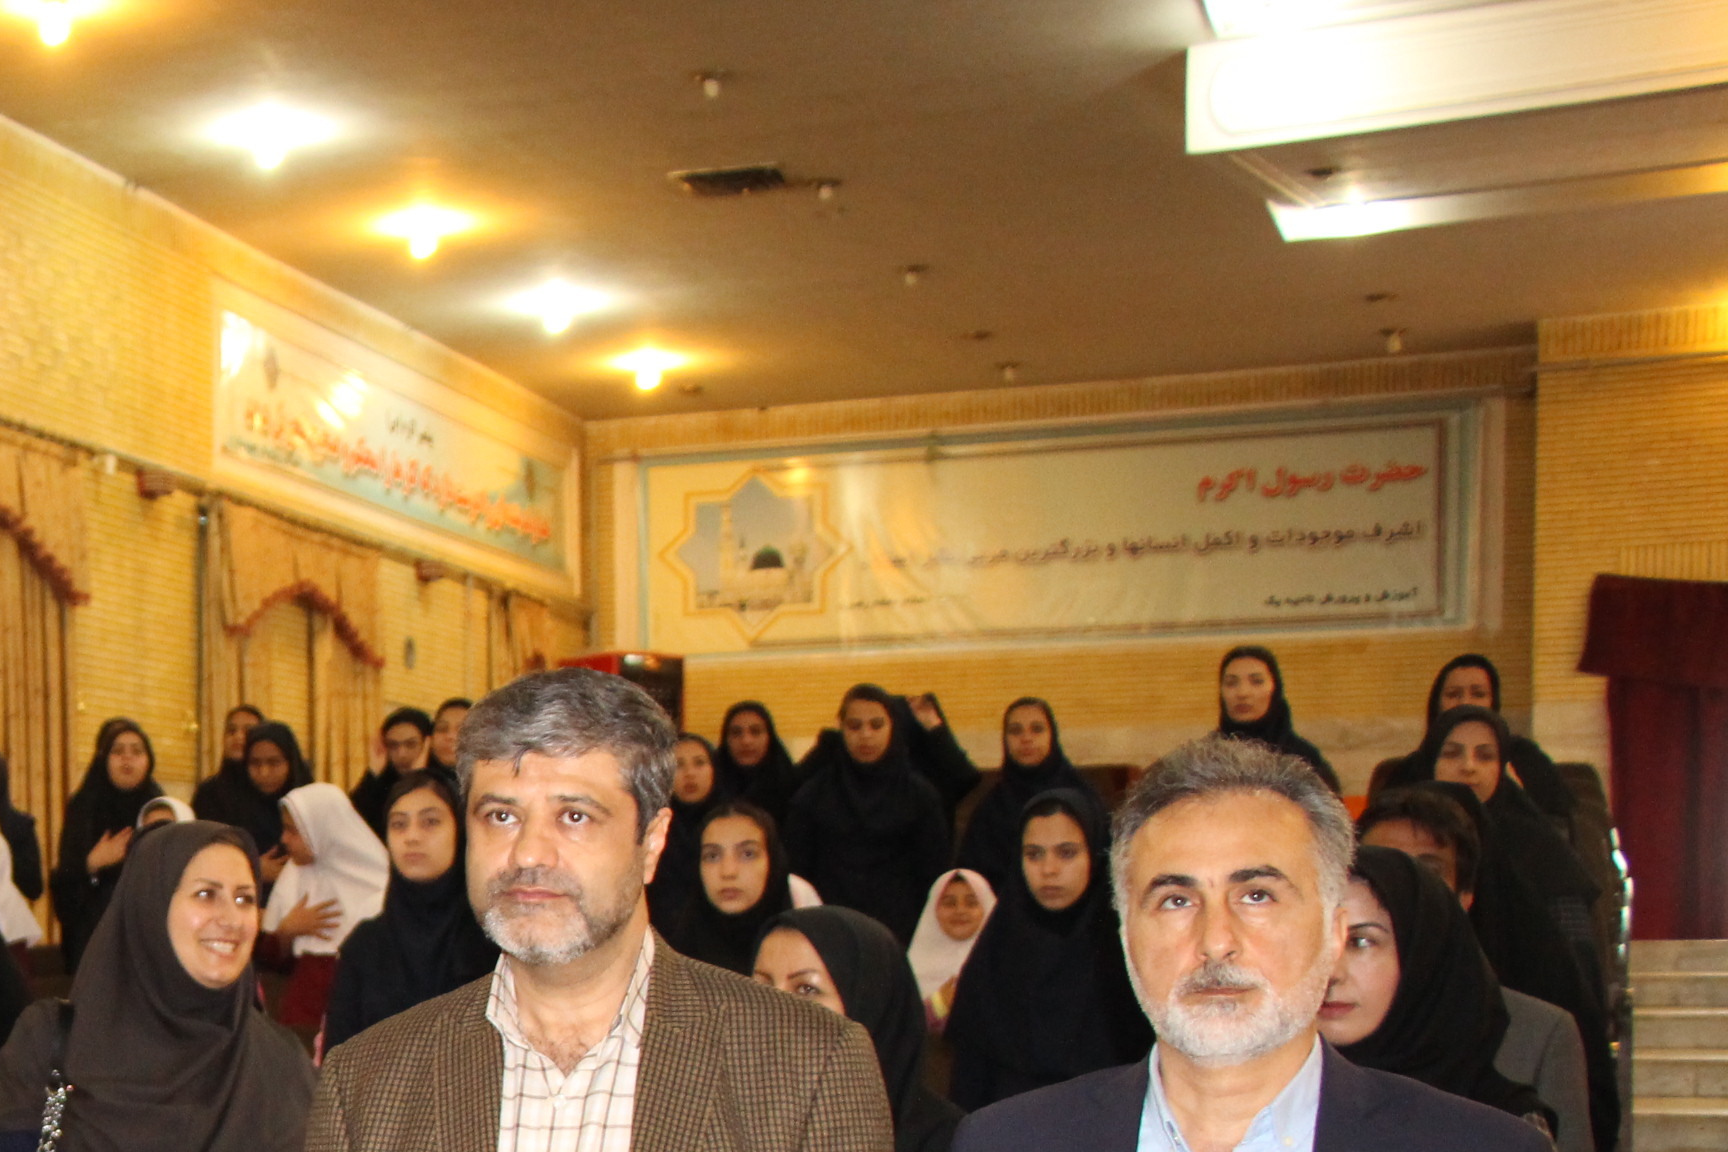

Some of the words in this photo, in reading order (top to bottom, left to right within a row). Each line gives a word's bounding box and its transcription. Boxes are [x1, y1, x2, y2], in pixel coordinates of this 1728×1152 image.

[1196, 467, 1257, 503] اکرم
[1261, 465, 1335, 499] رسول
[1340, 459, 1429, 493] حضرت
[1193, 530, 1241, 554] اکمل
[1248, 533, 1260, 551] و
[1265, 527, 1355, 549] موجودات
[1362, 520, 1423, 542] اشرف
[1106, 541, 1118, 560] و
[1122, 533, 1188, 557] انسانها
